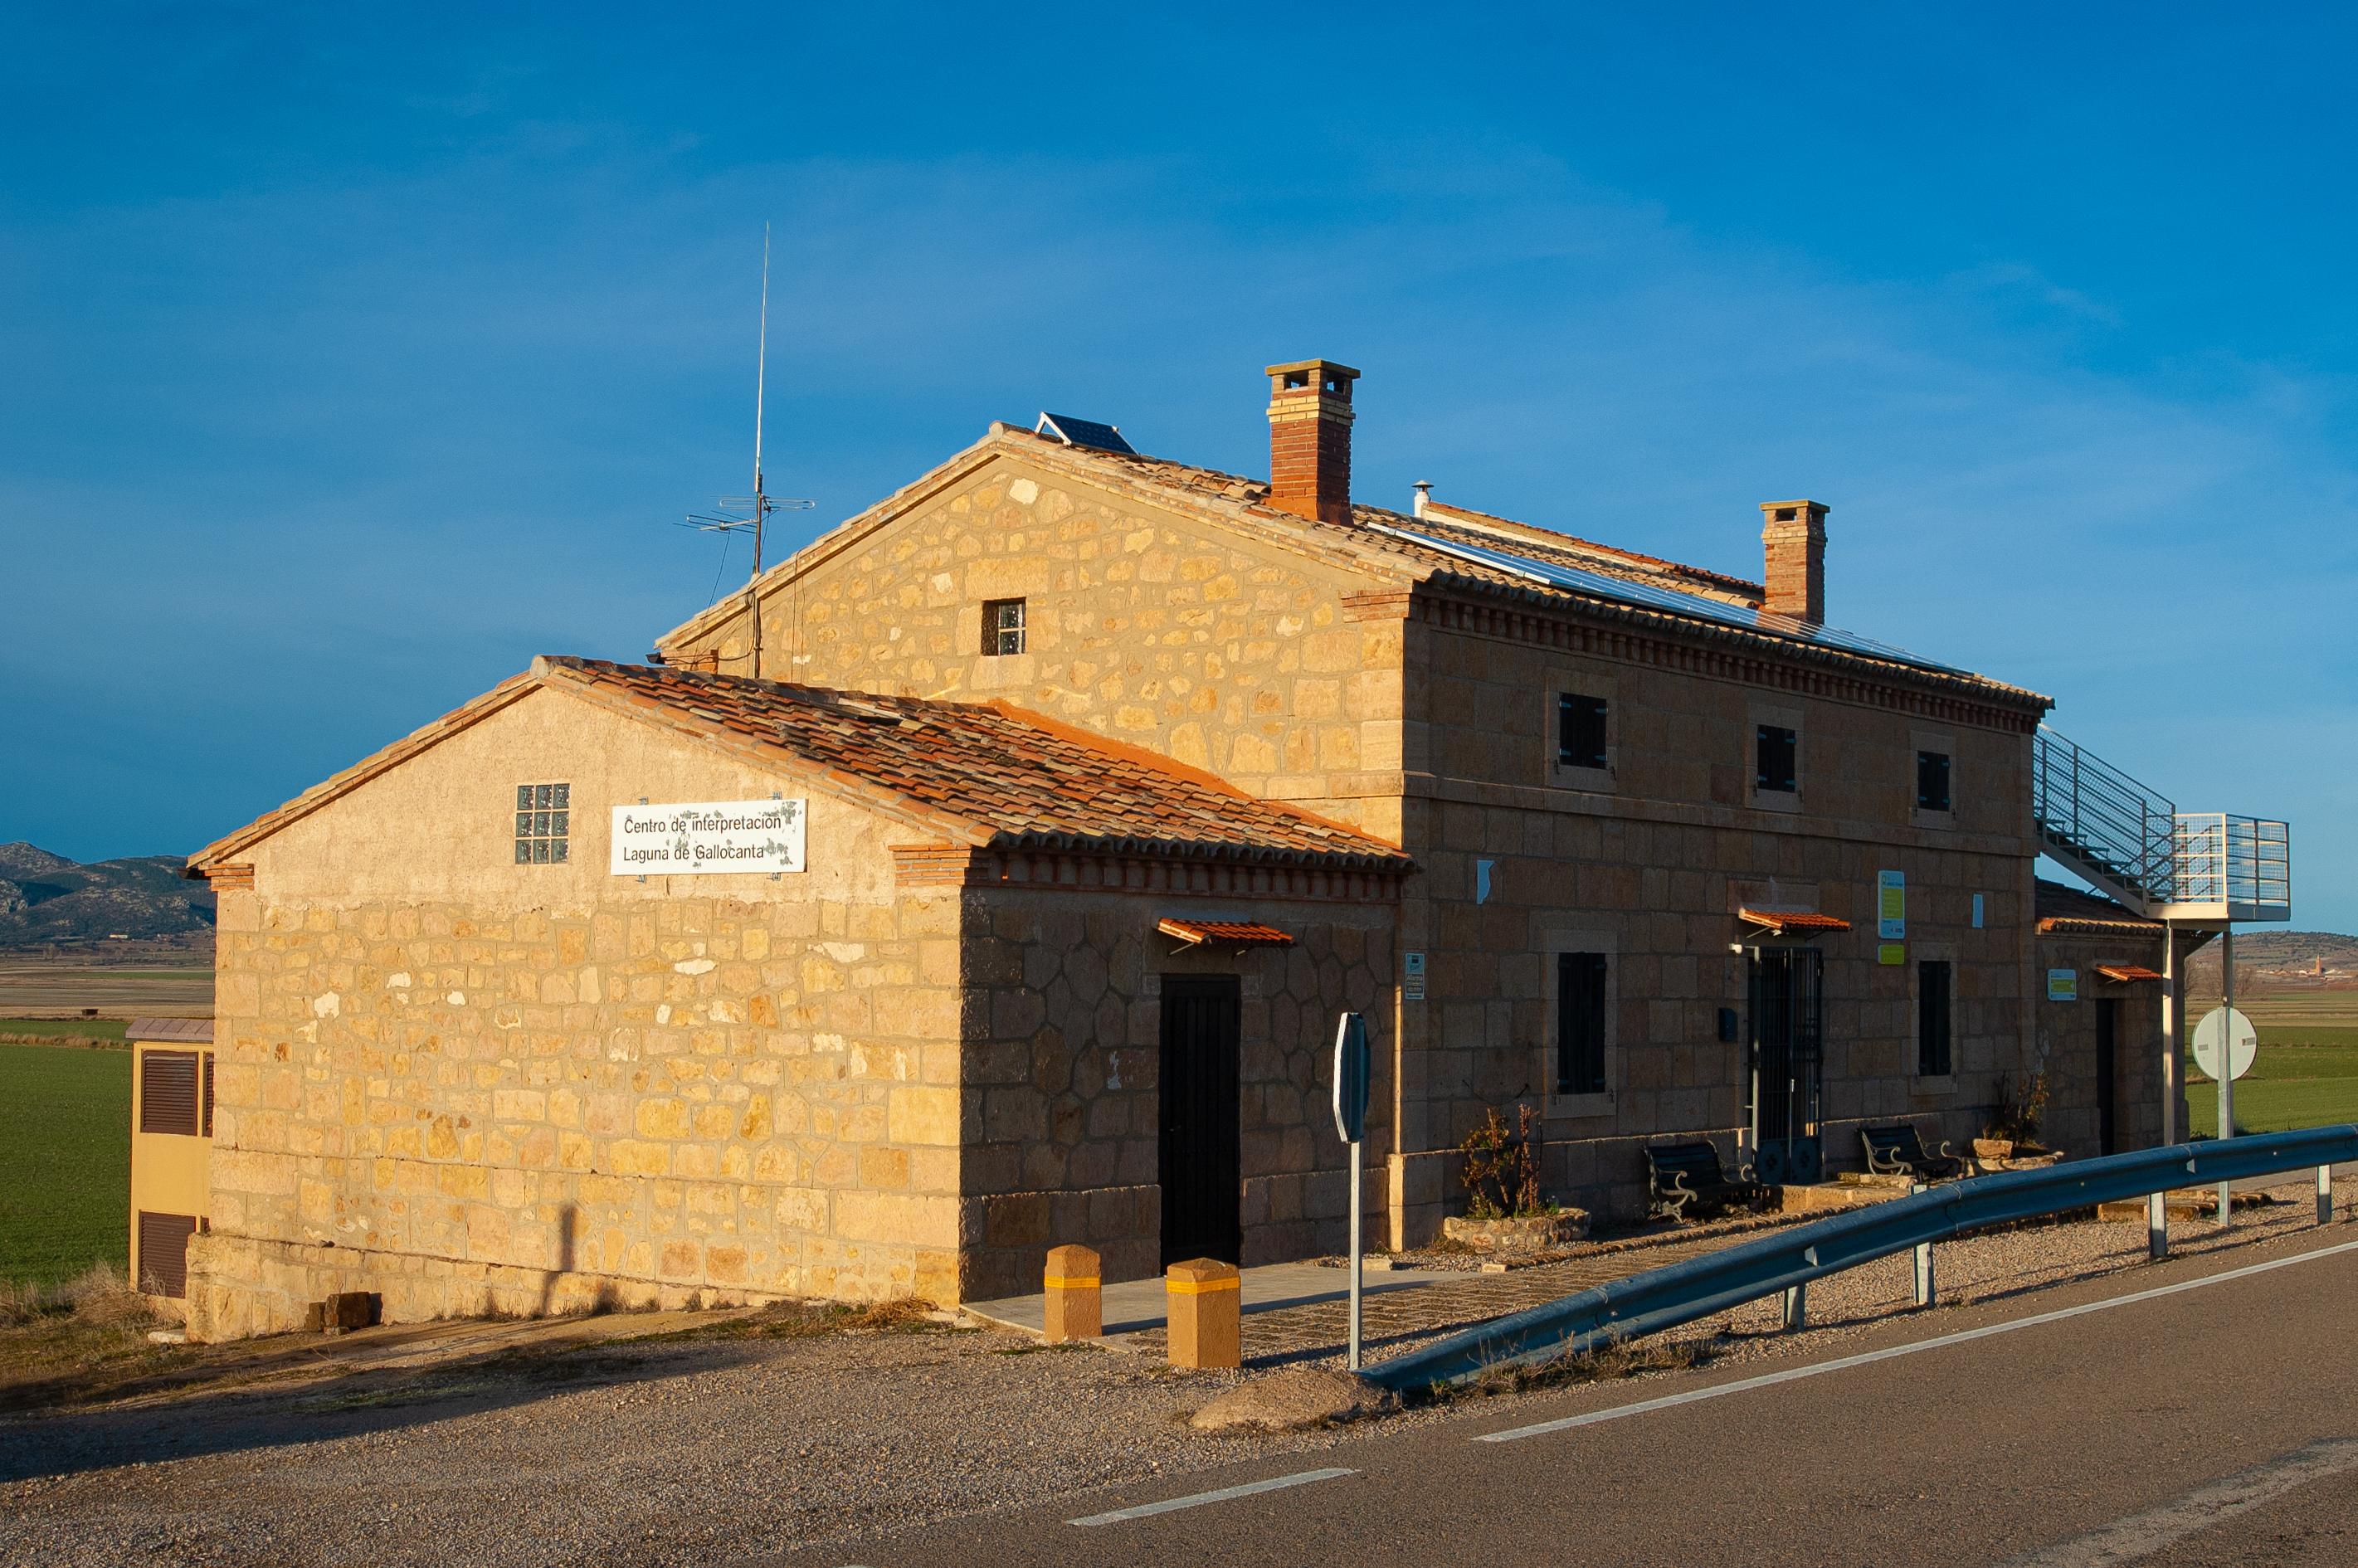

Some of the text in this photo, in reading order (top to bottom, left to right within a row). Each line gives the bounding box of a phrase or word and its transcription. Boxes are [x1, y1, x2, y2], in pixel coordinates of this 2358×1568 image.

[624, 815, 782, 834] Centro de interpretación
[623, 844, 764, 864] Laguna de Gallocanta
